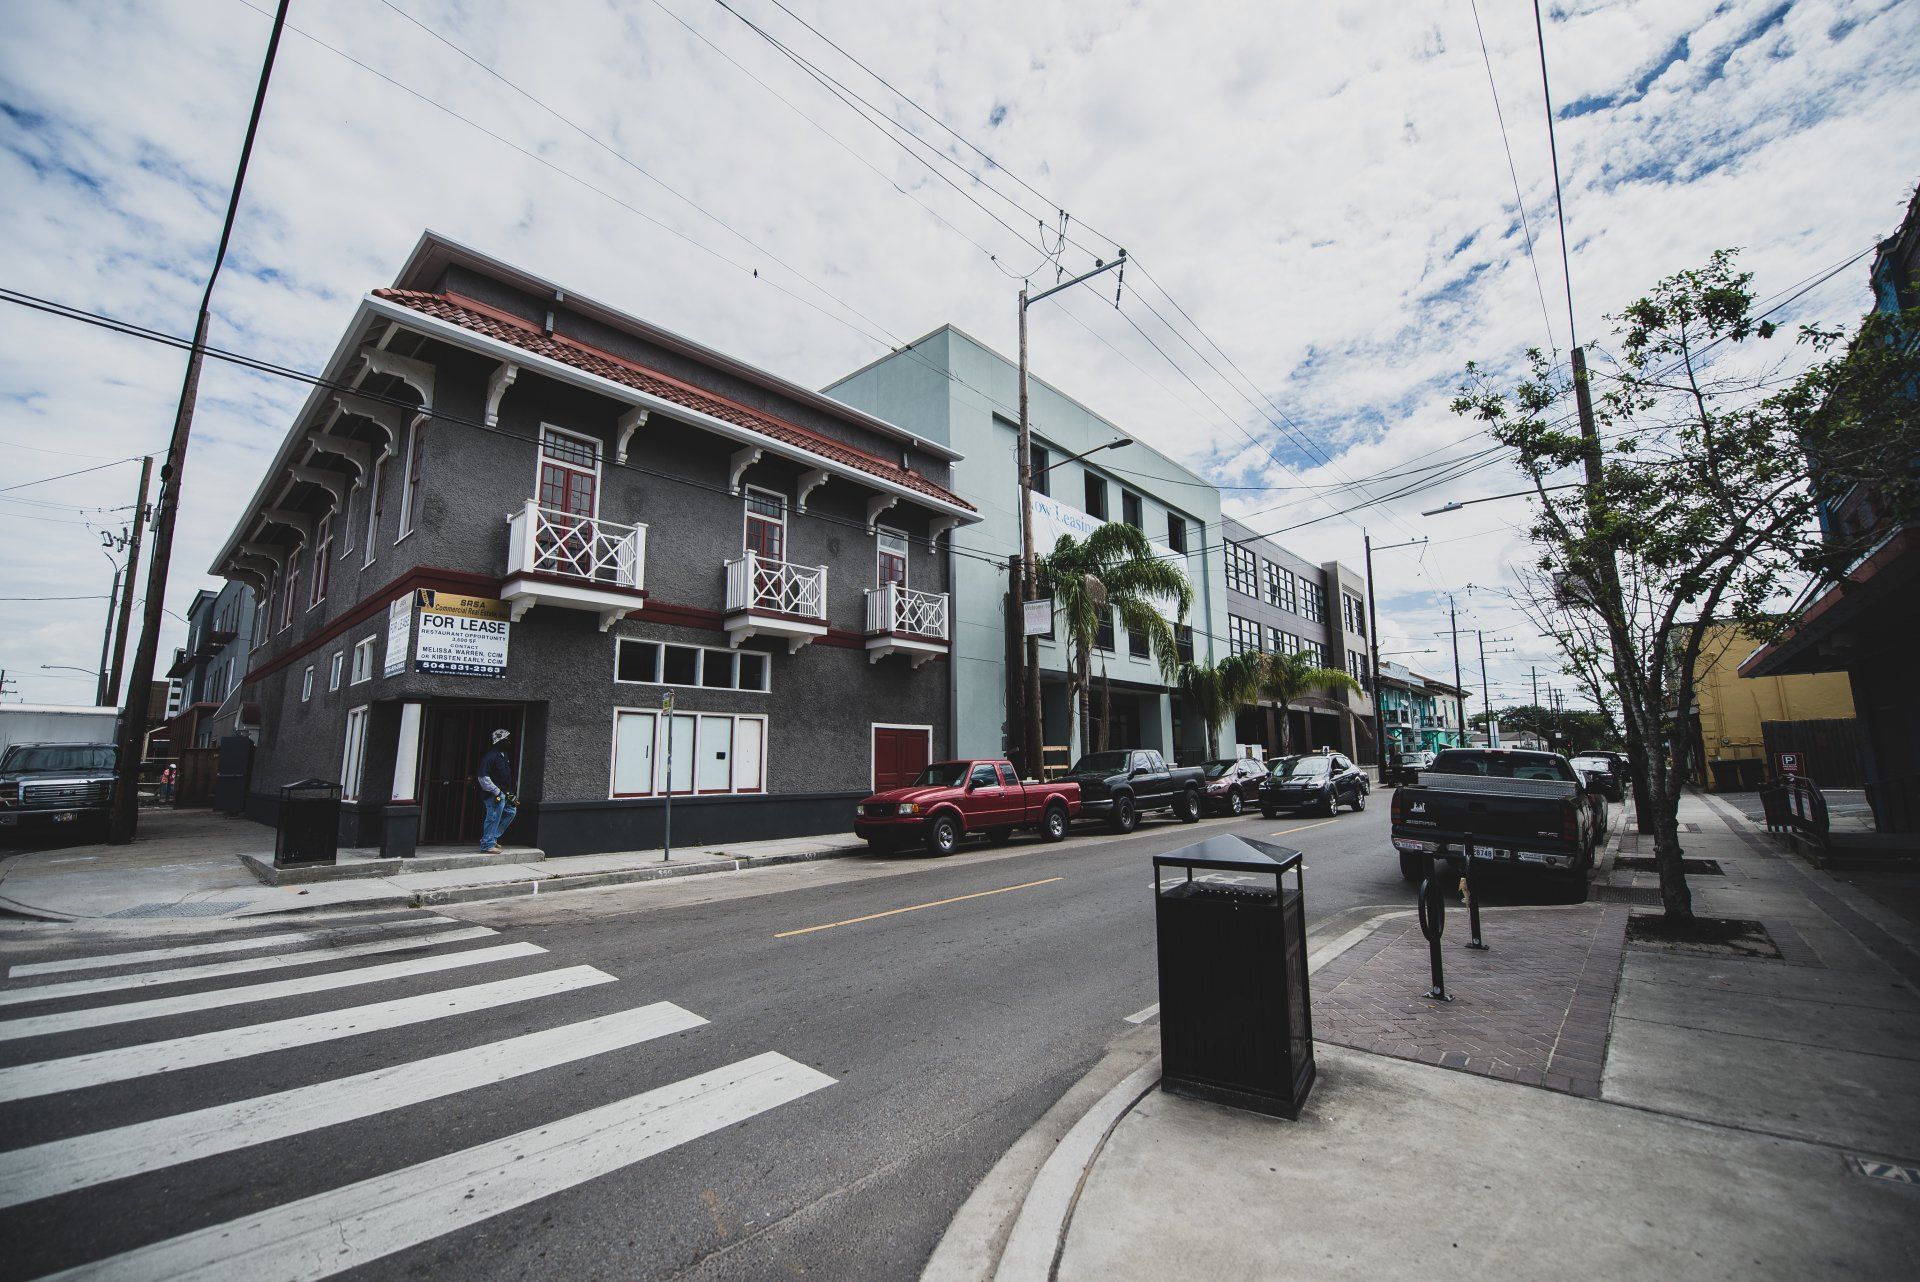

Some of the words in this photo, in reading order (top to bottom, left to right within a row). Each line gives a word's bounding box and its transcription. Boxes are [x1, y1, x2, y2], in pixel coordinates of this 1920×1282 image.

[1031, 501, 1052, 516] ow
[435, 603, 468, 614] Commercial
[460, 599, 486, 609] SRSA
[424, 614, 455, 628] FOR
[460, 618, 506, 634] LEASE
[421, 628, 463, 638] RESTAURANT
[464, 631, 506, 642] OPPORTUNITY
[422, 646, 452, 654] MELISSA
[422, 661, 500, 673] 504-831-2363
